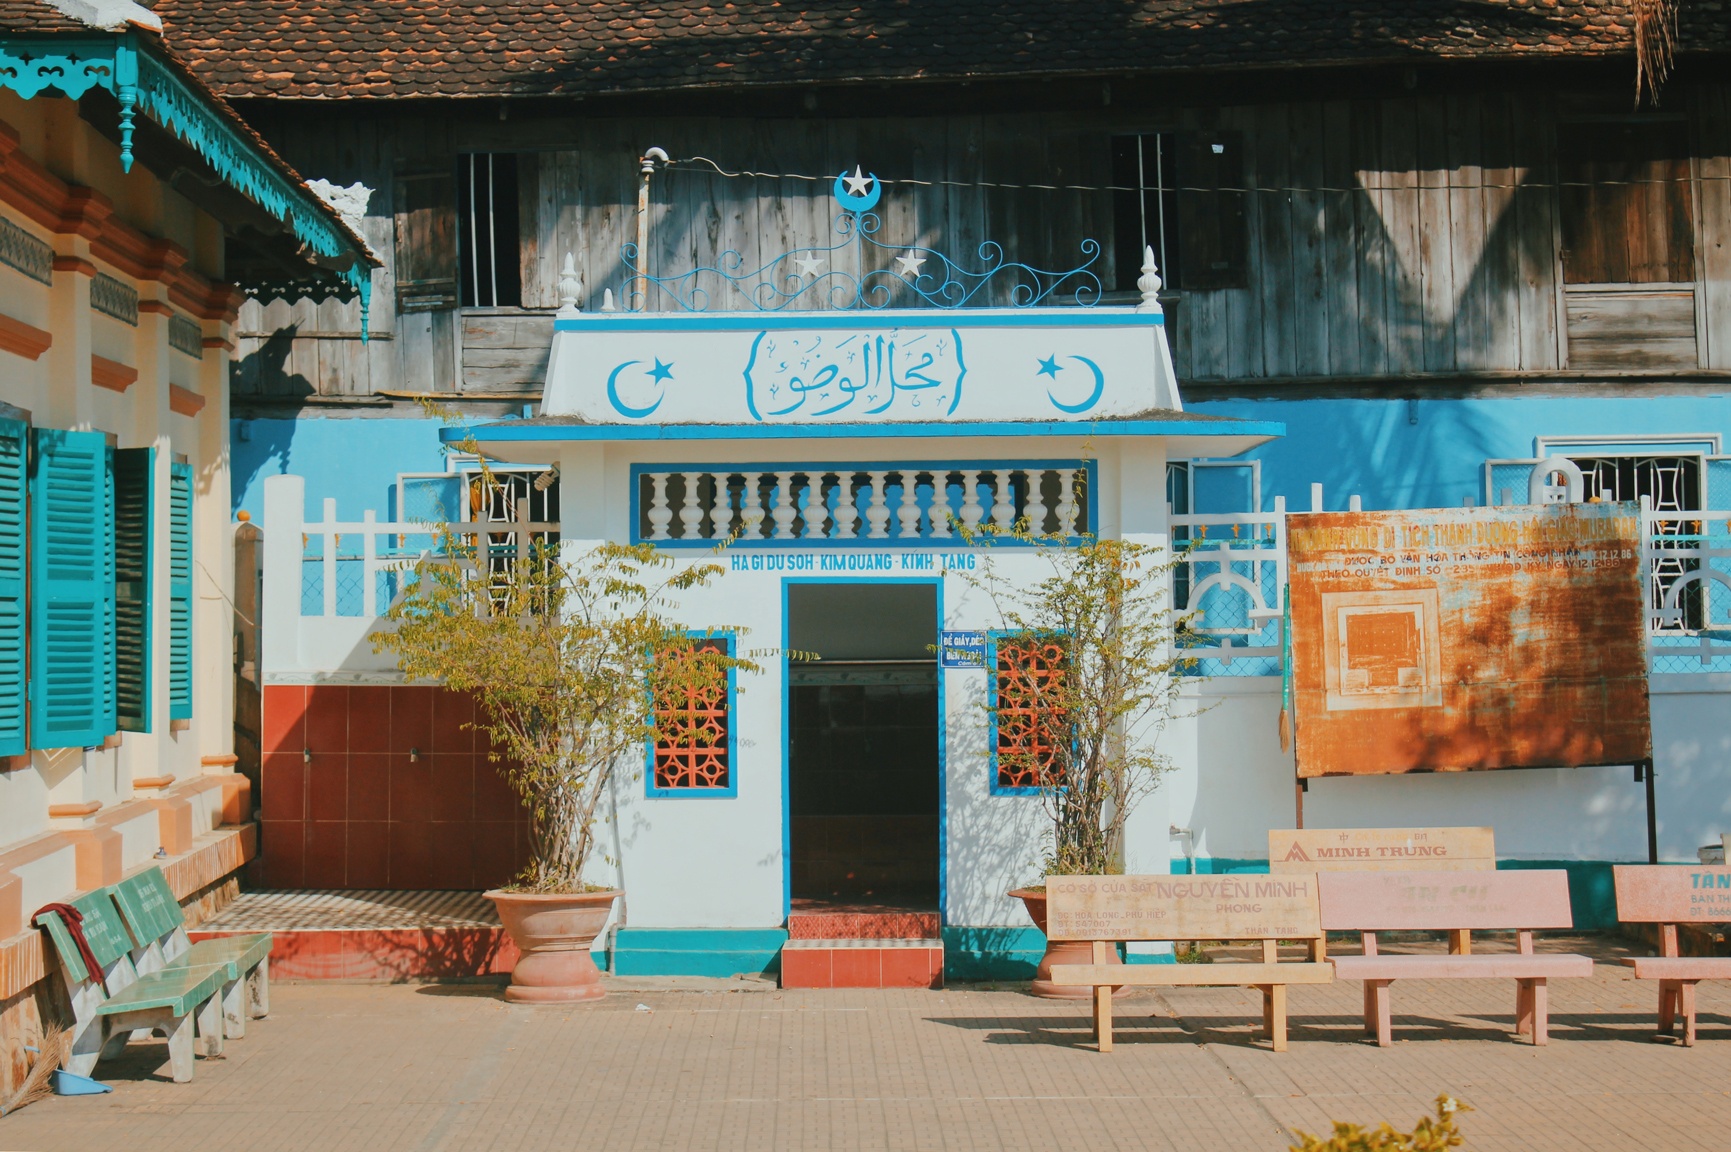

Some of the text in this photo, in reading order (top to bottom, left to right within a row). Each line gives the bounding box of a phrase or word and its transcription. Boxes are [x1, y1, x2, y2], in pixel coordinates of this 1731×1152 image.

[787, 553, 814, 571] SOH
[820, 553, 847, 571] KIM
[848, 553, 892, 571] QUANG
[1317, 845, 1448, 858] MINH TRUNG
[1216, 903, 1263, 914] PHONG
